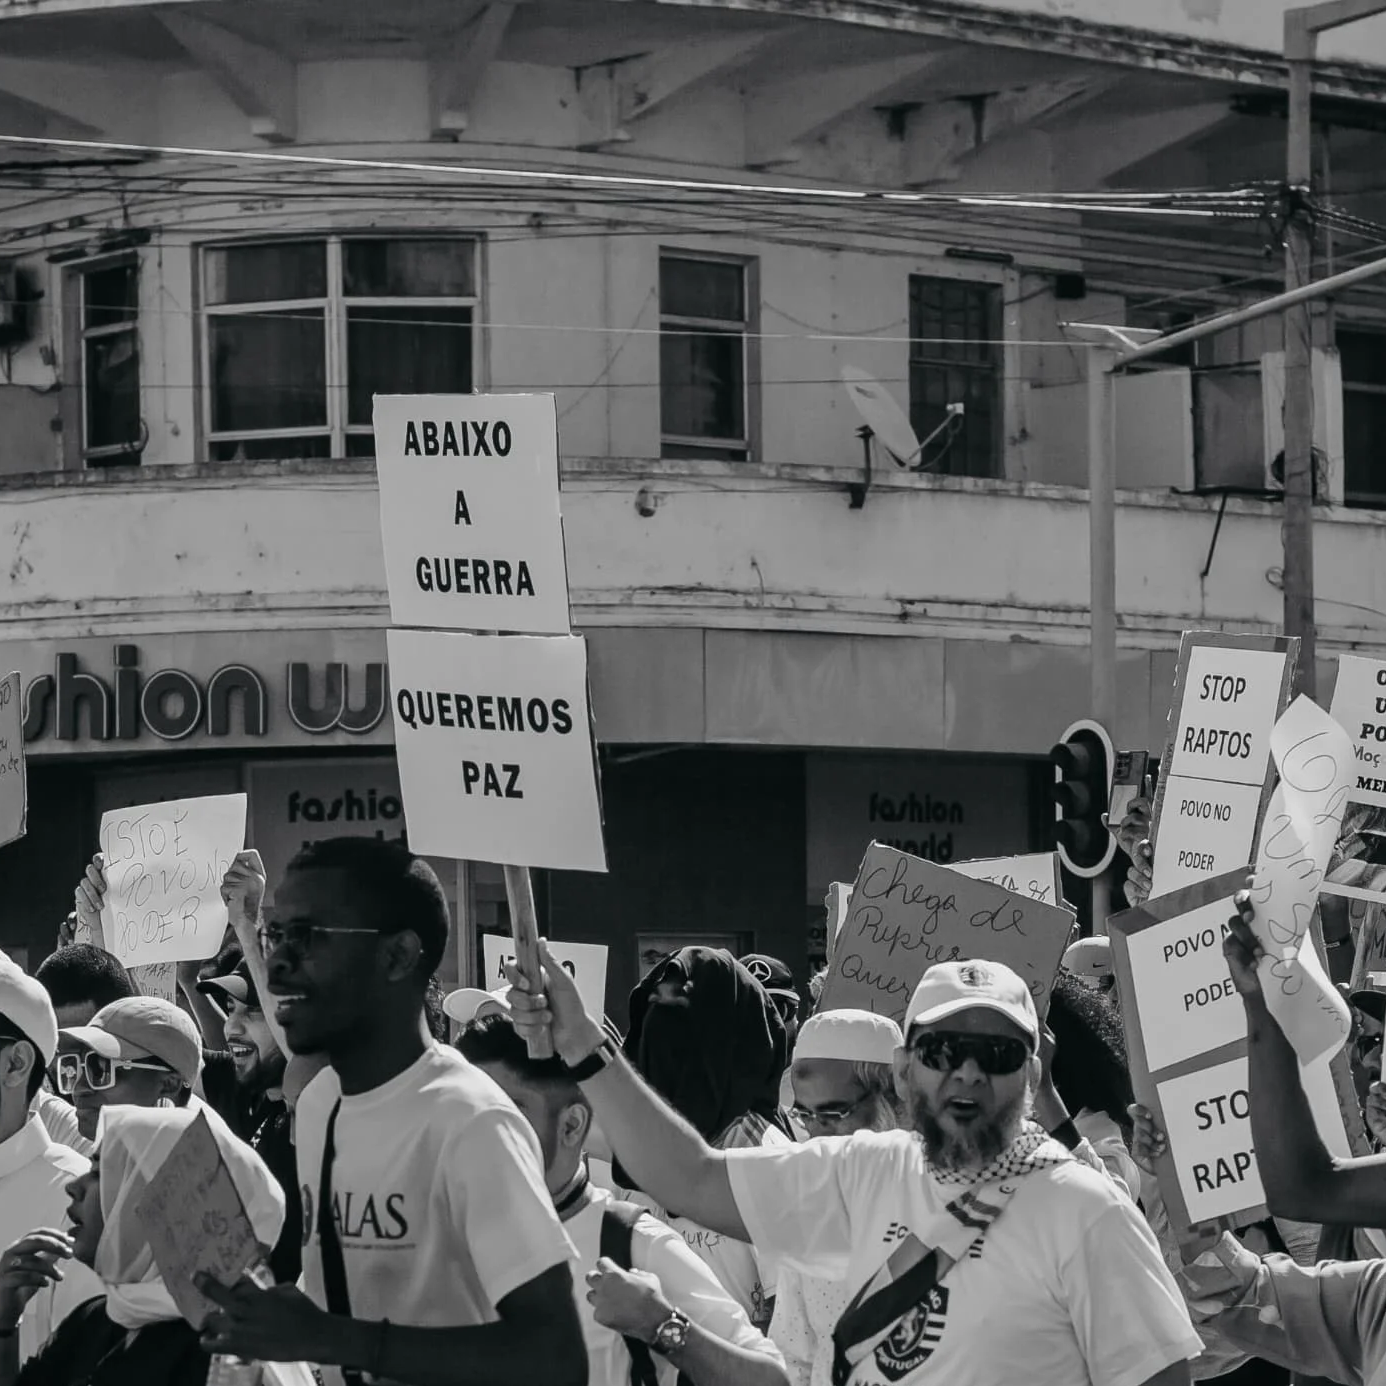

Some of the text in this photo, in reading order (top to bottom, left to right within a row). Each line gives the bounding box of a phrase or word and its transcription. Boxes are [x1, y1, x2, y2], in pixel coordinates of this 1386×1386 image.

[404, 421, 512, 457] ABAIXO
[454, 490, 472, 525] A
[416, 556, 535, 597] GUERRA
[1200, 673, 1247, 703] STOP
[397, 688, 573, 735] QUEREMOS
[1182, 726, 1252, 759] RAPTOS
[462, 760, 524, 799] PAZ
[288, 788, 402, 823] fashio
[869, 791, 964, 824] fashion
[1180, 799, 1232, 822] POVO NO
[102, 813, 166, 871] ISTO
[1177, 850, 1215, 872] PODER
[120, 858, 197, 908] POVO
[862, 856, 958, 935] Chega
[969, 899, 1027, 936] de
[117, 895, 201, 958] PODER
[1163, 927, 1216, 963] POVO
[1183, 977, 1236, 1012] PODE
[1194, 1089, 1250, 1131] STO
[1192, 1149, 1255, 1194] RAP
